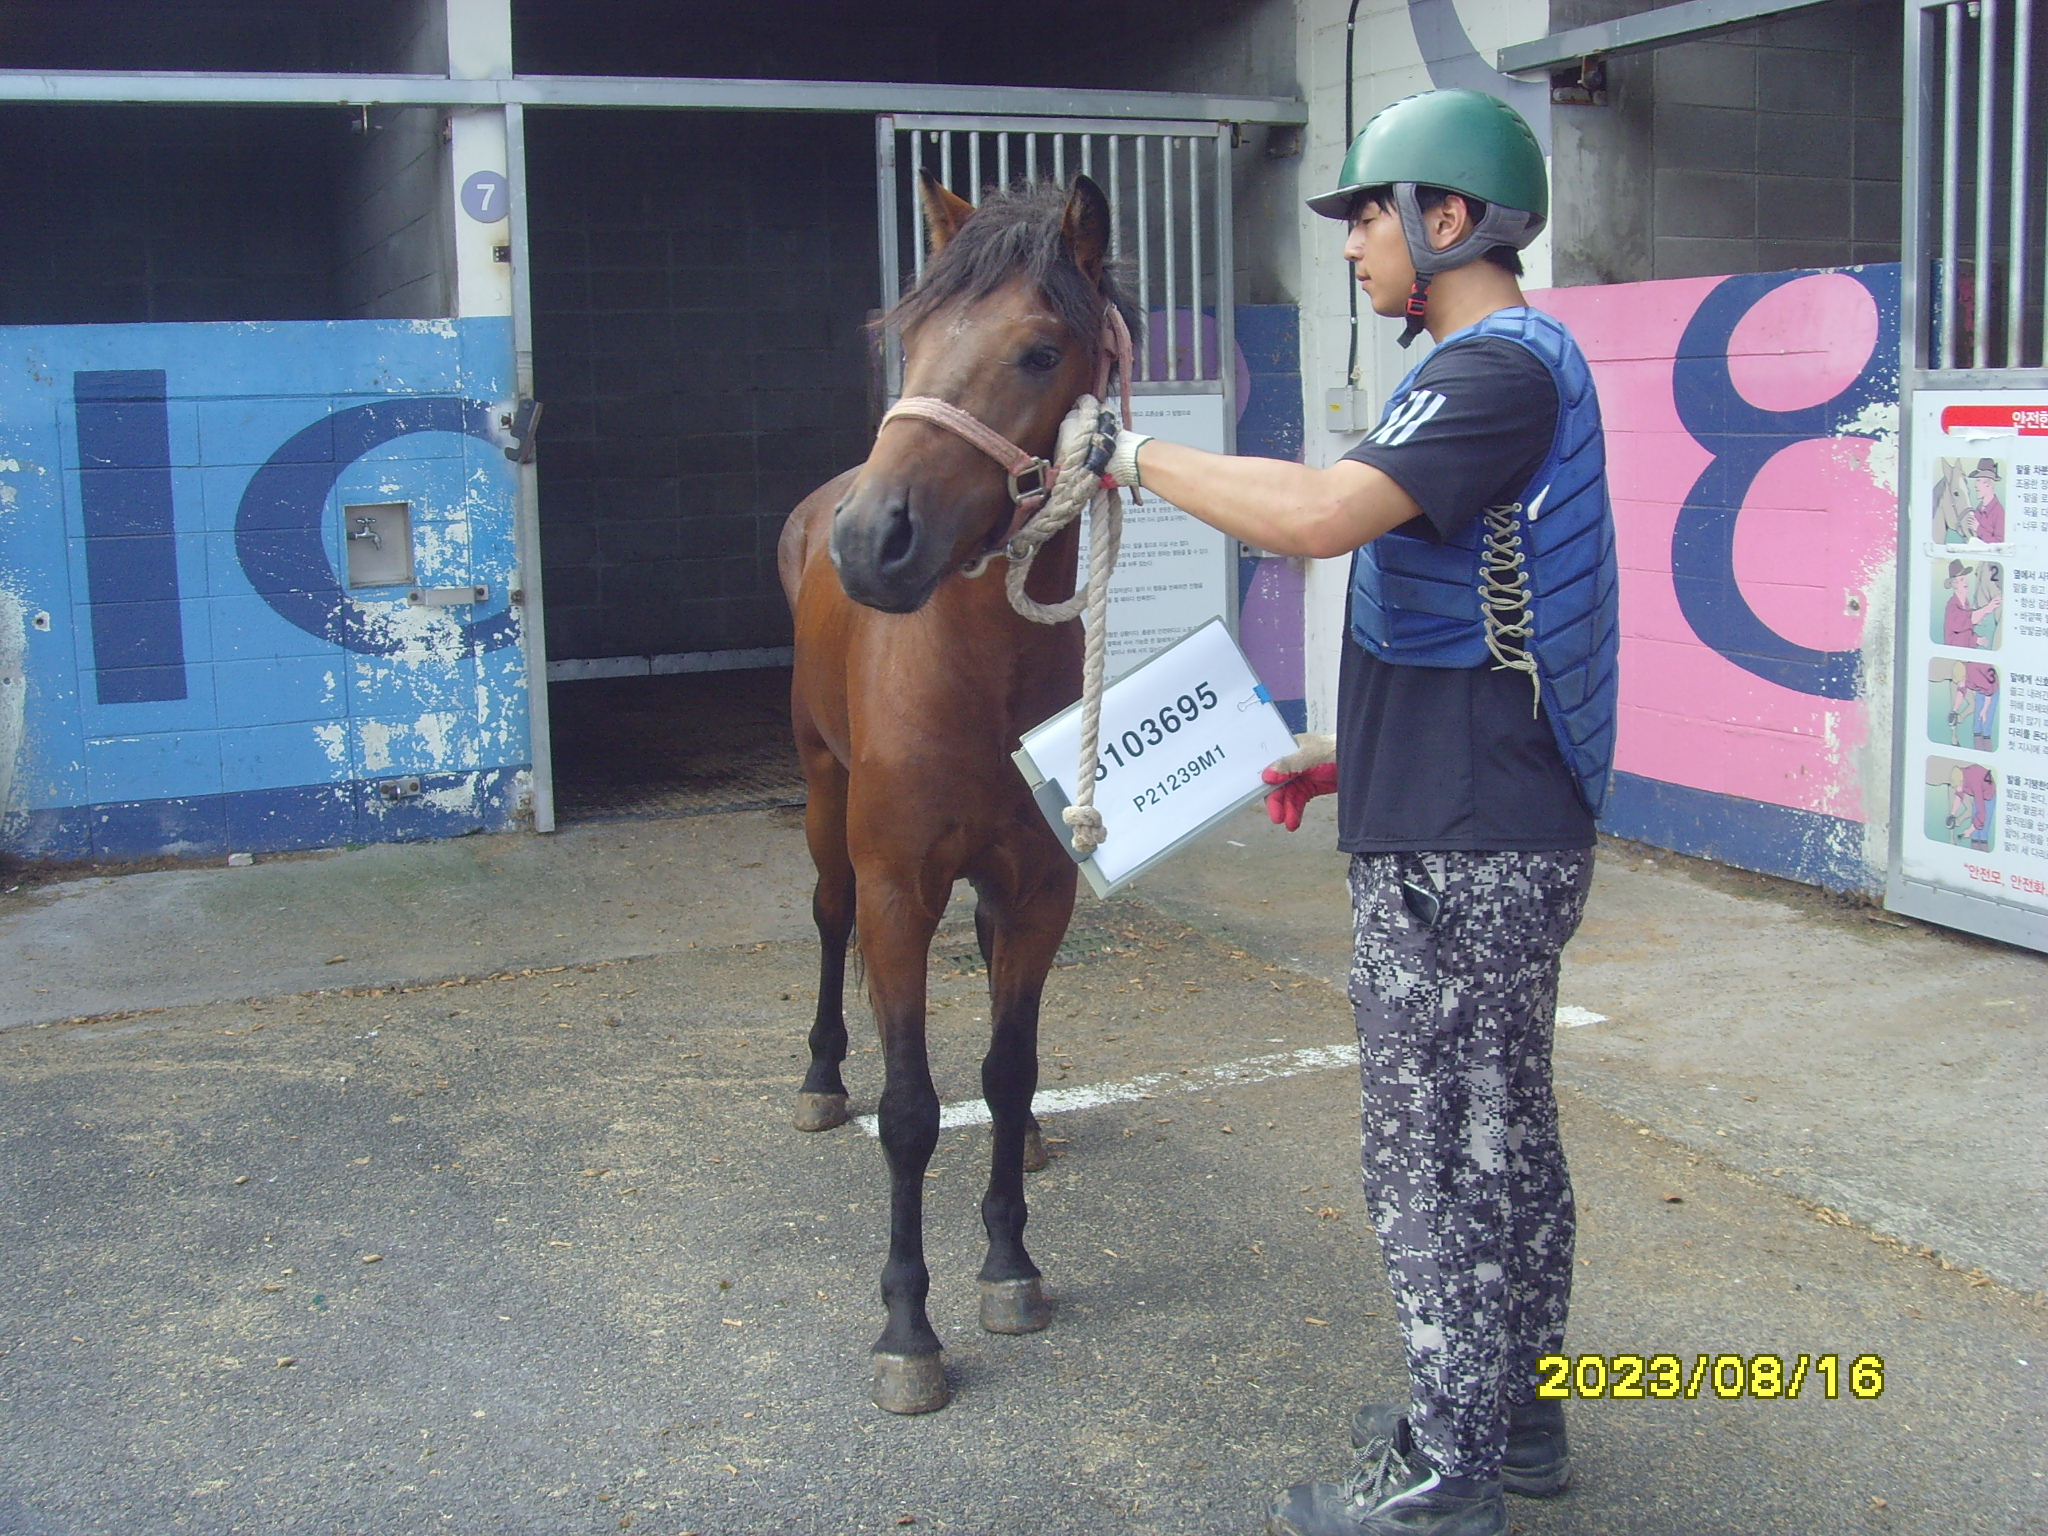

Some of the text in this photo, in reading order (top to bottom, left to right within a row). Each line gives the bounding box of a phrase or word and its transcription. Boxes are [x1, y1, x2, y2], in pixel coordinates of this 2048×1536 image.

[476, 183, 495, 211] 7
[1990, 565, 1999, 582] 2
[1987, 667, 1996, 684] 3
[2009, 727, 2030, 739] 다리를
[1132, 744, 1227, 812] P21239M1
[1984, 770, 1992, 784] 4
